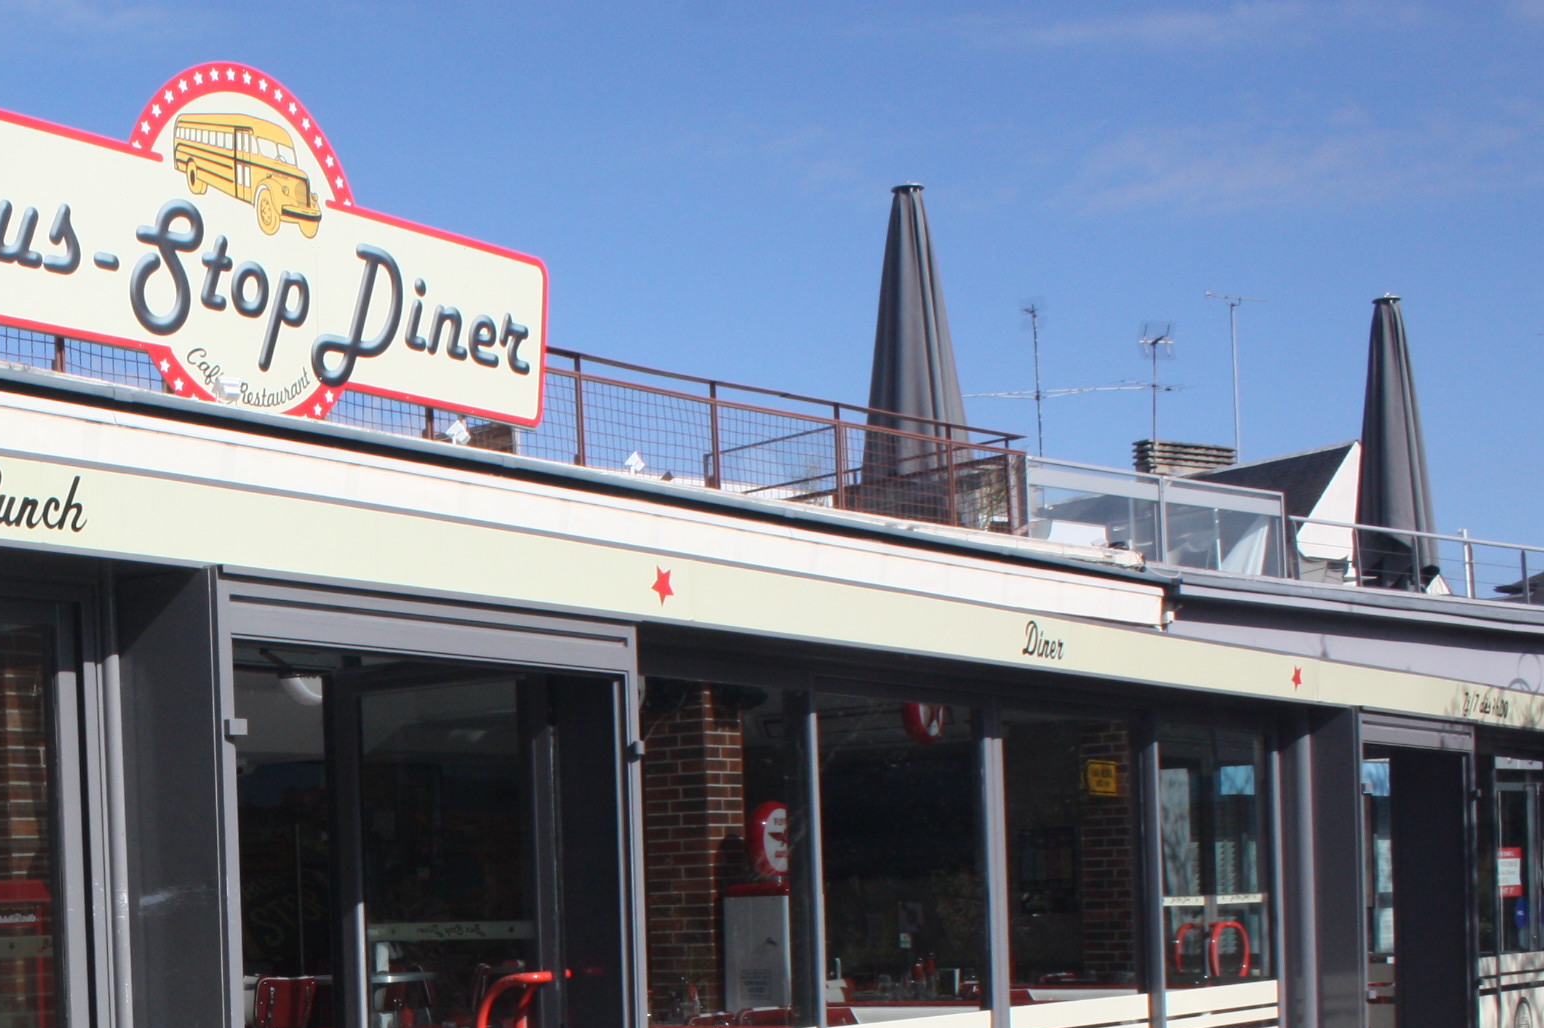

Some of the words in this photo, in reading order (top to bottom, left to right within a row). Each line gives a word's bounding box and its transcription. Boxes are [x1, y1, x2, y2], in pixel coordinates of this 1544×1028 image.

[310, 243, 530, 387] Diner
[186, 347, 224, 385] Caf
[239, 366, 311, 407] Restaurant
[1022, 620, 1064, 660] Diner
